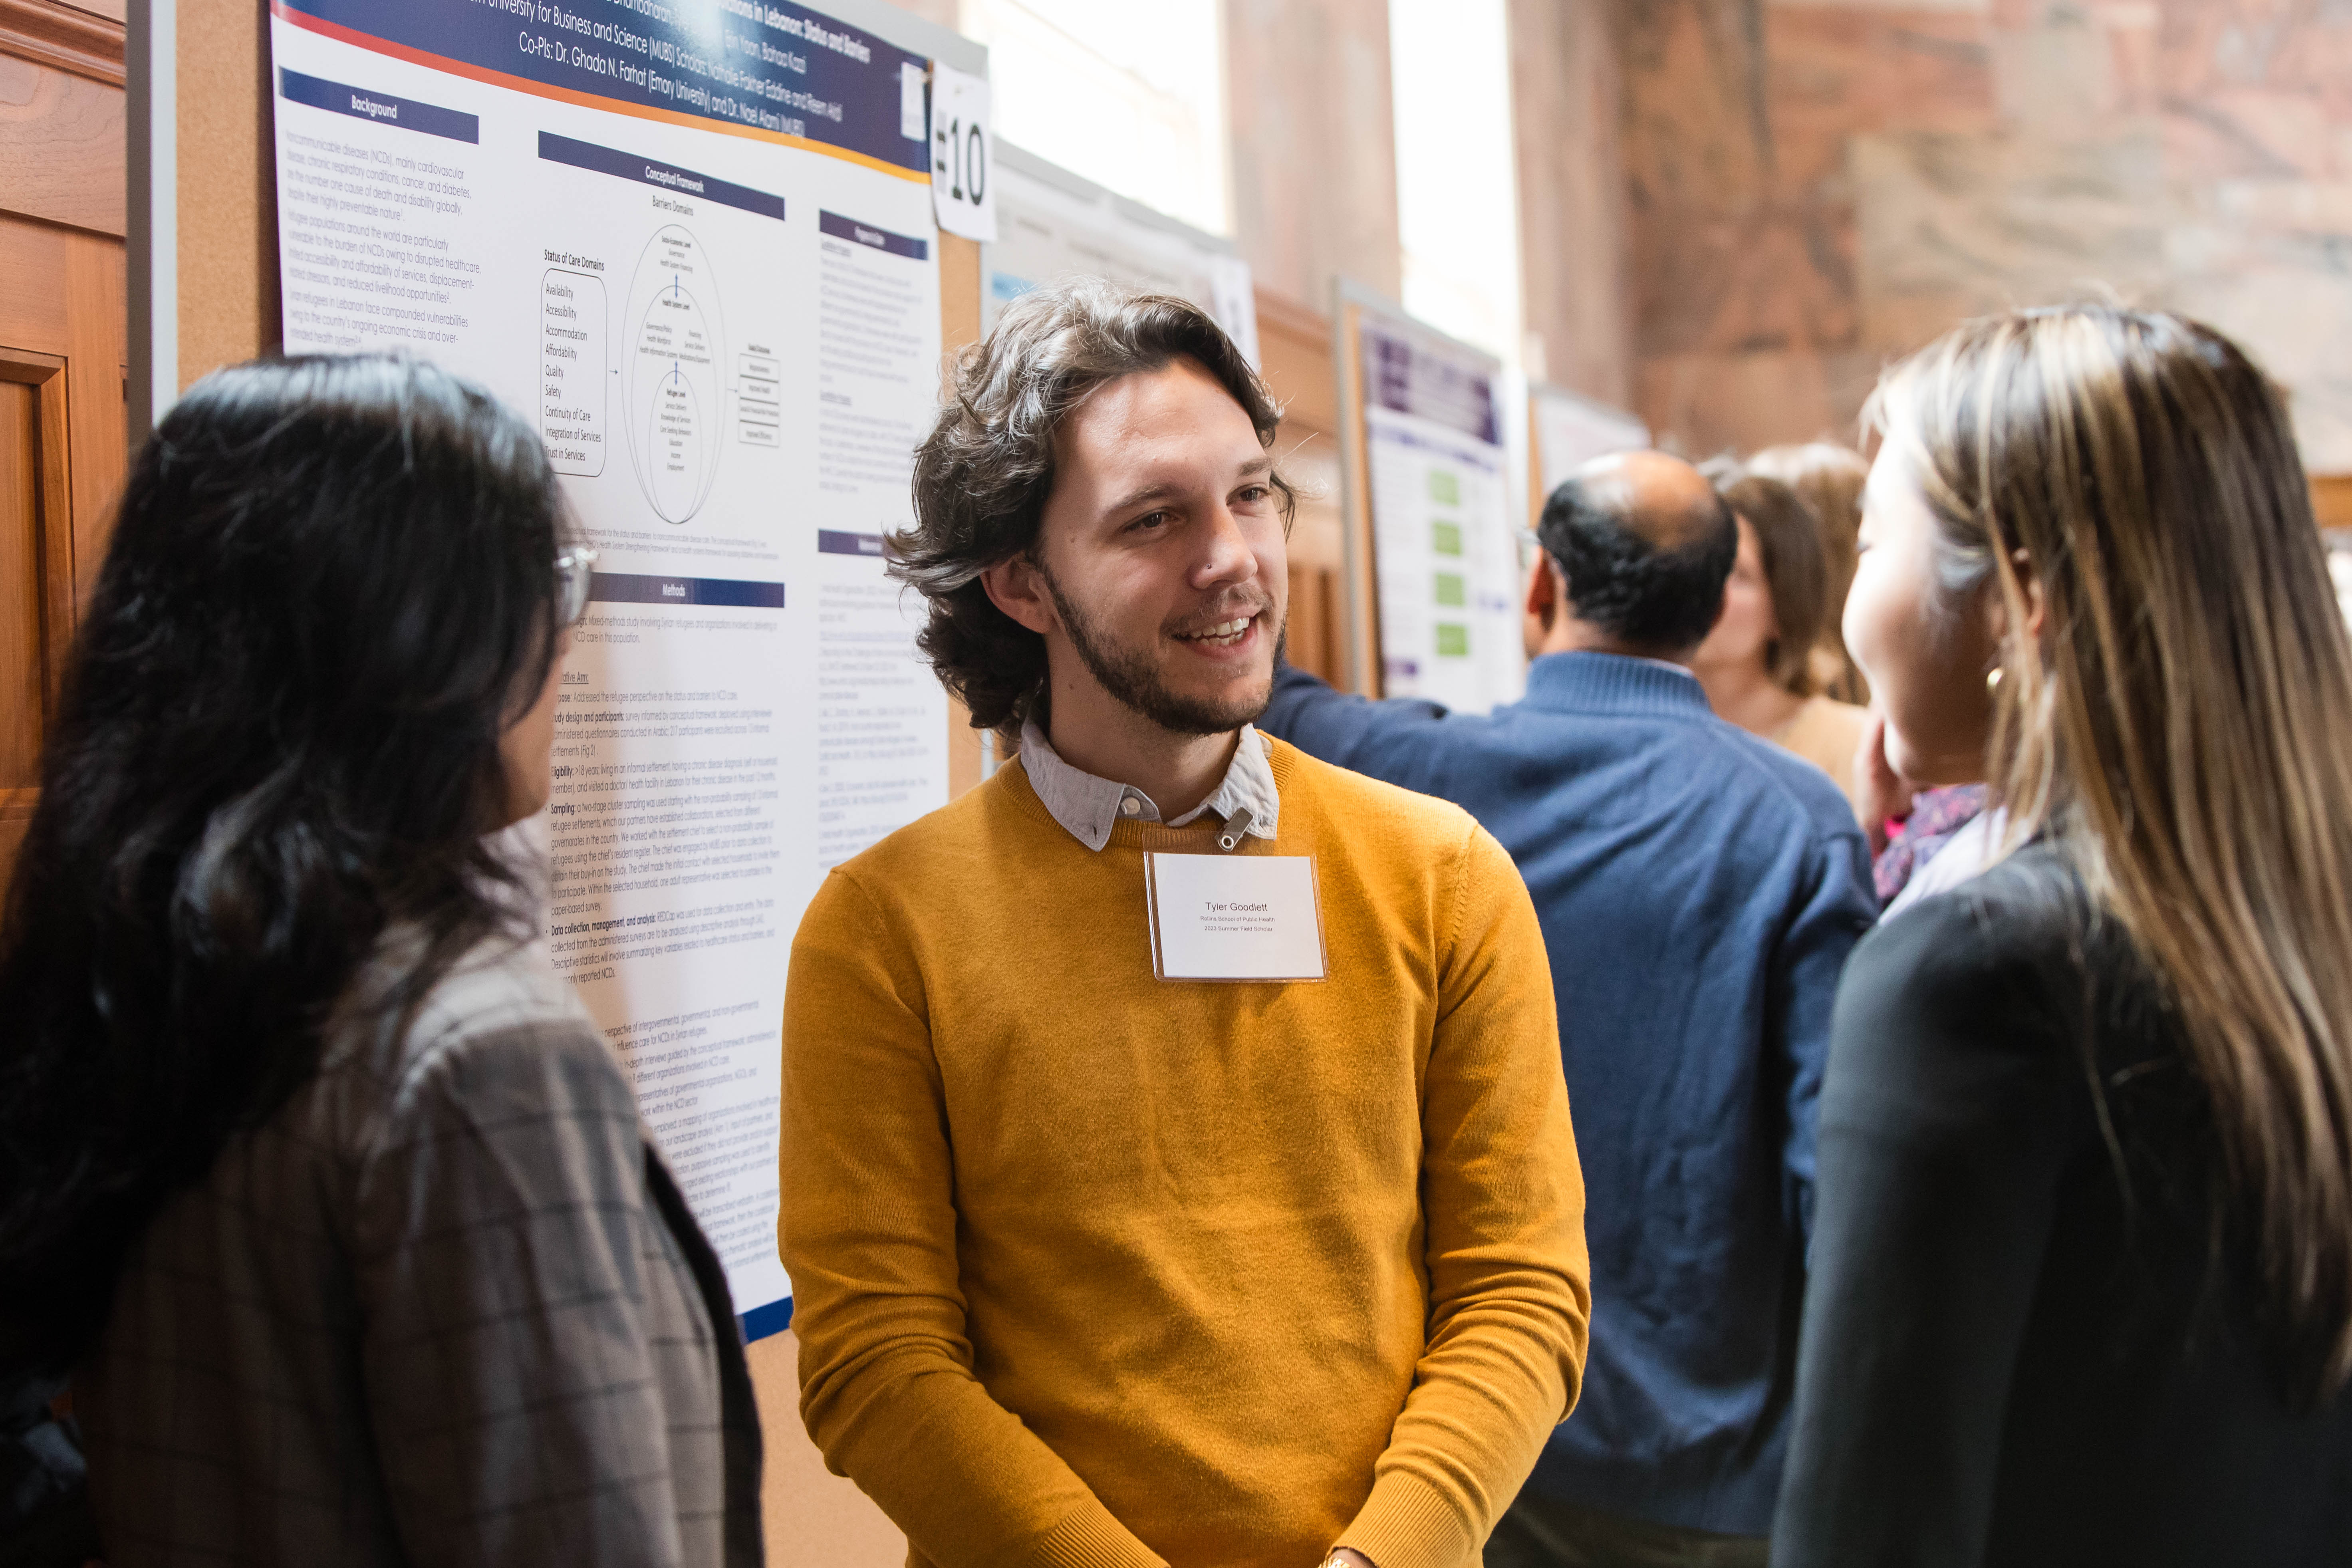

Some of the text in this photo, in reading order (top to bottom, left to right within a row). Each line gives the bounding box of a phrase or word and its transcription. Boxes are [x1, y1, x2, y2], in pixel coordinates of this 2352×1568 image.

[538, 2, 551, 23] for
[554, 6, 591, 35] Business
[593, 23, 611, 42] and
[614, 25, 647, 54] Science
[649, 36, 675, 67] (MUBS)
[556, 42, 569, 64] Dr.
[572, 46, 605, 73] Ghada
[608, 58, 617, 77] N.
[620, 60, 646, 86] Farhat
[648, 69, 675, 99] (Emory
[351, 95, 397, 119] Background
[396, 157, 416, 172] mainly
[418, 163, 464, 179] cardiovascular
[645, 165, 676, 185] Conceptual
[402, 177, 425, 190] cancer,
[428, 182, 441, 193] and
[442, 183, 471, 199] diabetes,
[373, 187, 462, 216] death and disability globally,
[653, 195, 693, 216] Barriers Domains
[383, 230, 448, 252] world are particularly
[386, 248, 405, 264] owing
[407, 251, 413, 262] to
[415, 252, 444, 268] disrupted
[445, 258, 481, 274] healthcare,
[544, 249, 604, 271] Status of Care Domains
[394, 266, 474, 289] of services, displacement-
[546, 283, 574, 301] Availability
[381, 307, 468, 327] compounded vulnerabilities
[546, 303, 577, 322] Accessibility
[379, 324, 458, 343] economic crisis and over-
[546, 324, 588, 341] Accommodation
[546, 343, 577, 362] Affordability
[546, 365, 564, 380] Quality
[546, 384, 561, 400] Safety
[546, 405, 591, 422] Continuity of Care
[546, 425, 601, 442] Integration of Services
[545, 446, 586, 461] Trust in Services
[662, 584, 685, 597] Methods
[586, 634, 598, 642] care
[599, 631, 603, 642] in
[573, 692, 599, 702] Addressed
[610, 691, 628, 705] refugee
[566, 711, 624, 724] design and participants:
[581, 744, 595, 758] (Fig 2)
[577, 782, 588, 792] and
[589, 781, 603, 792] visited
[551, 803, 576, 816] Sampling:
[582, 802, 606, 814] two-stage
[607, 800, 623, 810] cluster
[551, 817, 617, 833] refugee settlements, which
[551, 836, 584, 851] governorates
[586, 835, 590, 845] in
[600, 833, 620, 844] country.
[574, 851, 587, 865] using
[614, 848, 633, 859] resident
[581, 867, 596, 880] buy-in
[597, 869, 603, 877] on
[613, 865, 627, 876] study.
[558, 885, 587, 899] participate.
[551, 901, 602, 917] paper-based survey.
[1205, 902, 1268, 912] Tyler Goodlett
[551, 914, 656, 936] Data collection, management, and analysis:
[551, 940, 575, 953] collected
[576, 939, 588, 949] from
[598, 933, 629, 947] administered
[551, 953, 599, 970] Descriptive statistics
[579, 969, 600, 984] reported
